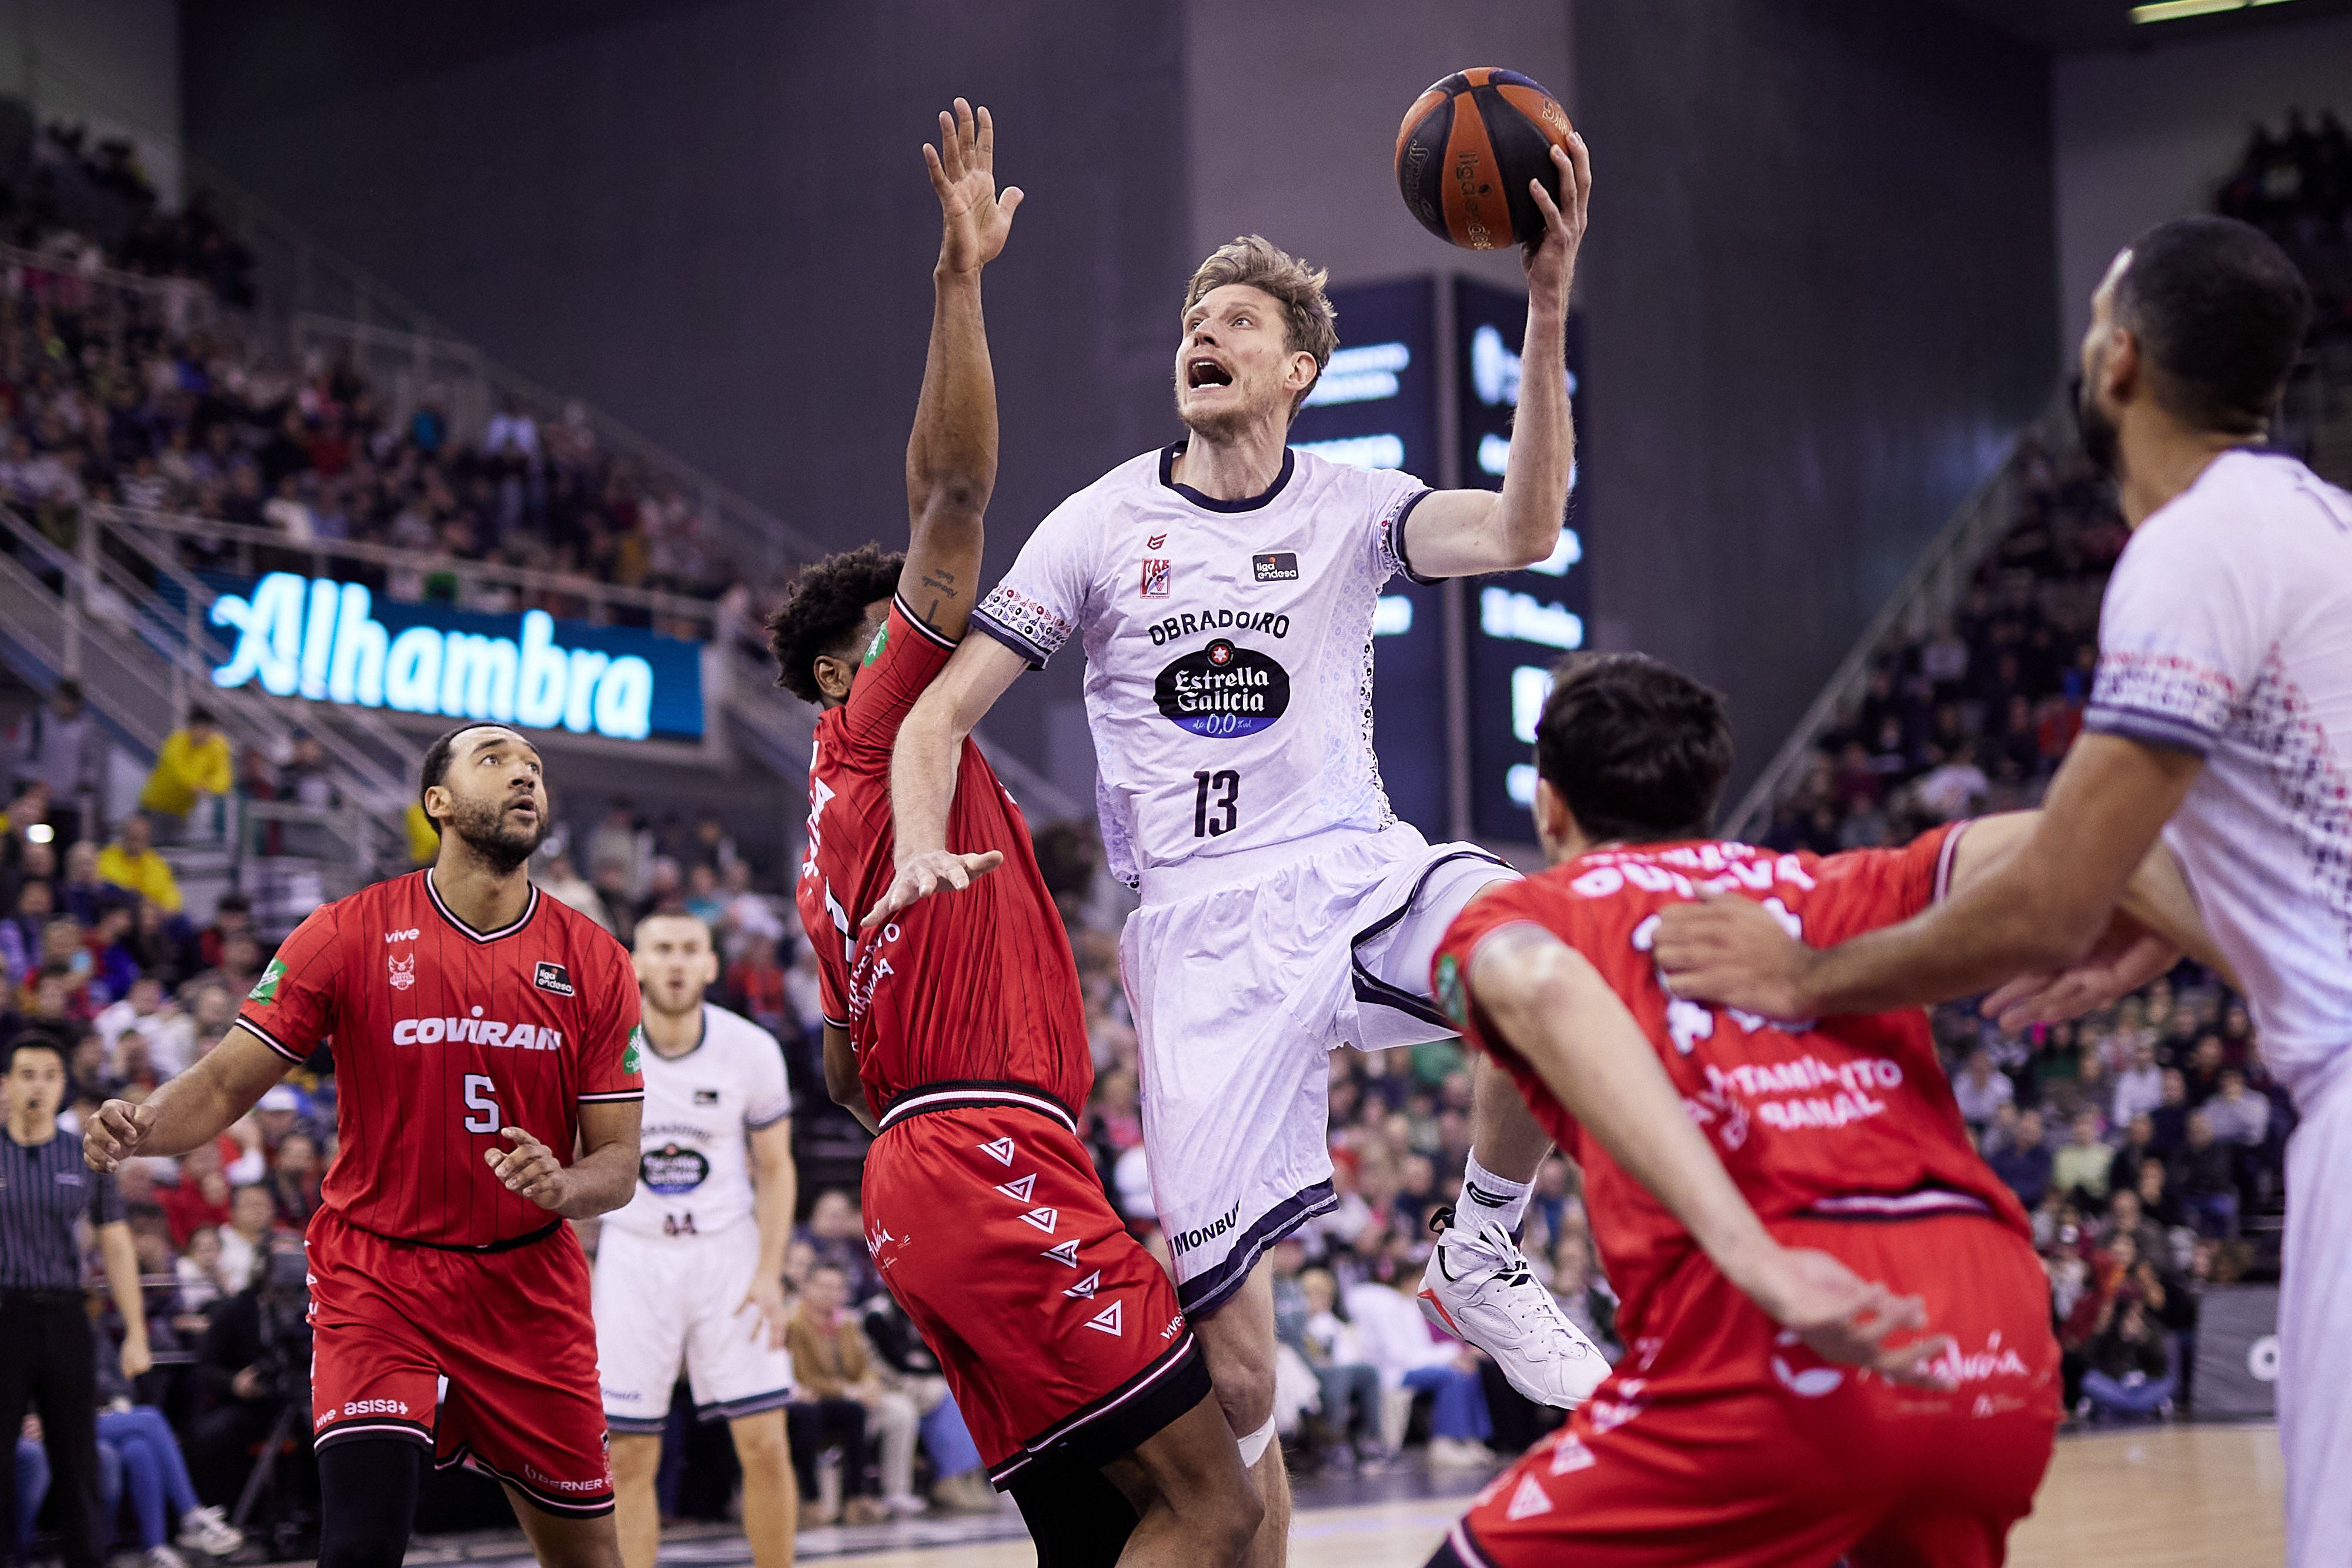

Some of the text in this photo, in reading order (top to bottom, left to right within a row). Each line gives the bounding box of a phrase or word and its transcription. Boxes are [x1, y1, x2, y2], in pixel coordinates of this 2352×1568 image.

[1256, 562, 1275, 572] liga
[1258, 569, 1297, 579] endesa
[1148, 609, 1289, 646] OBRADOIRO
[211, 571, 654, 741] Alhambra
[1175, 667, 1269, 691] Estrella
[1177, 688, 1265, 711] Galicia
[1206, 713, 1237, 734] 0,0
[1193, 769, 1240, 837] 13
[385, 928, 420, 943] vive
[538, 978, 572, 992] endesa
[463, 1074, 499, 1134] 5
